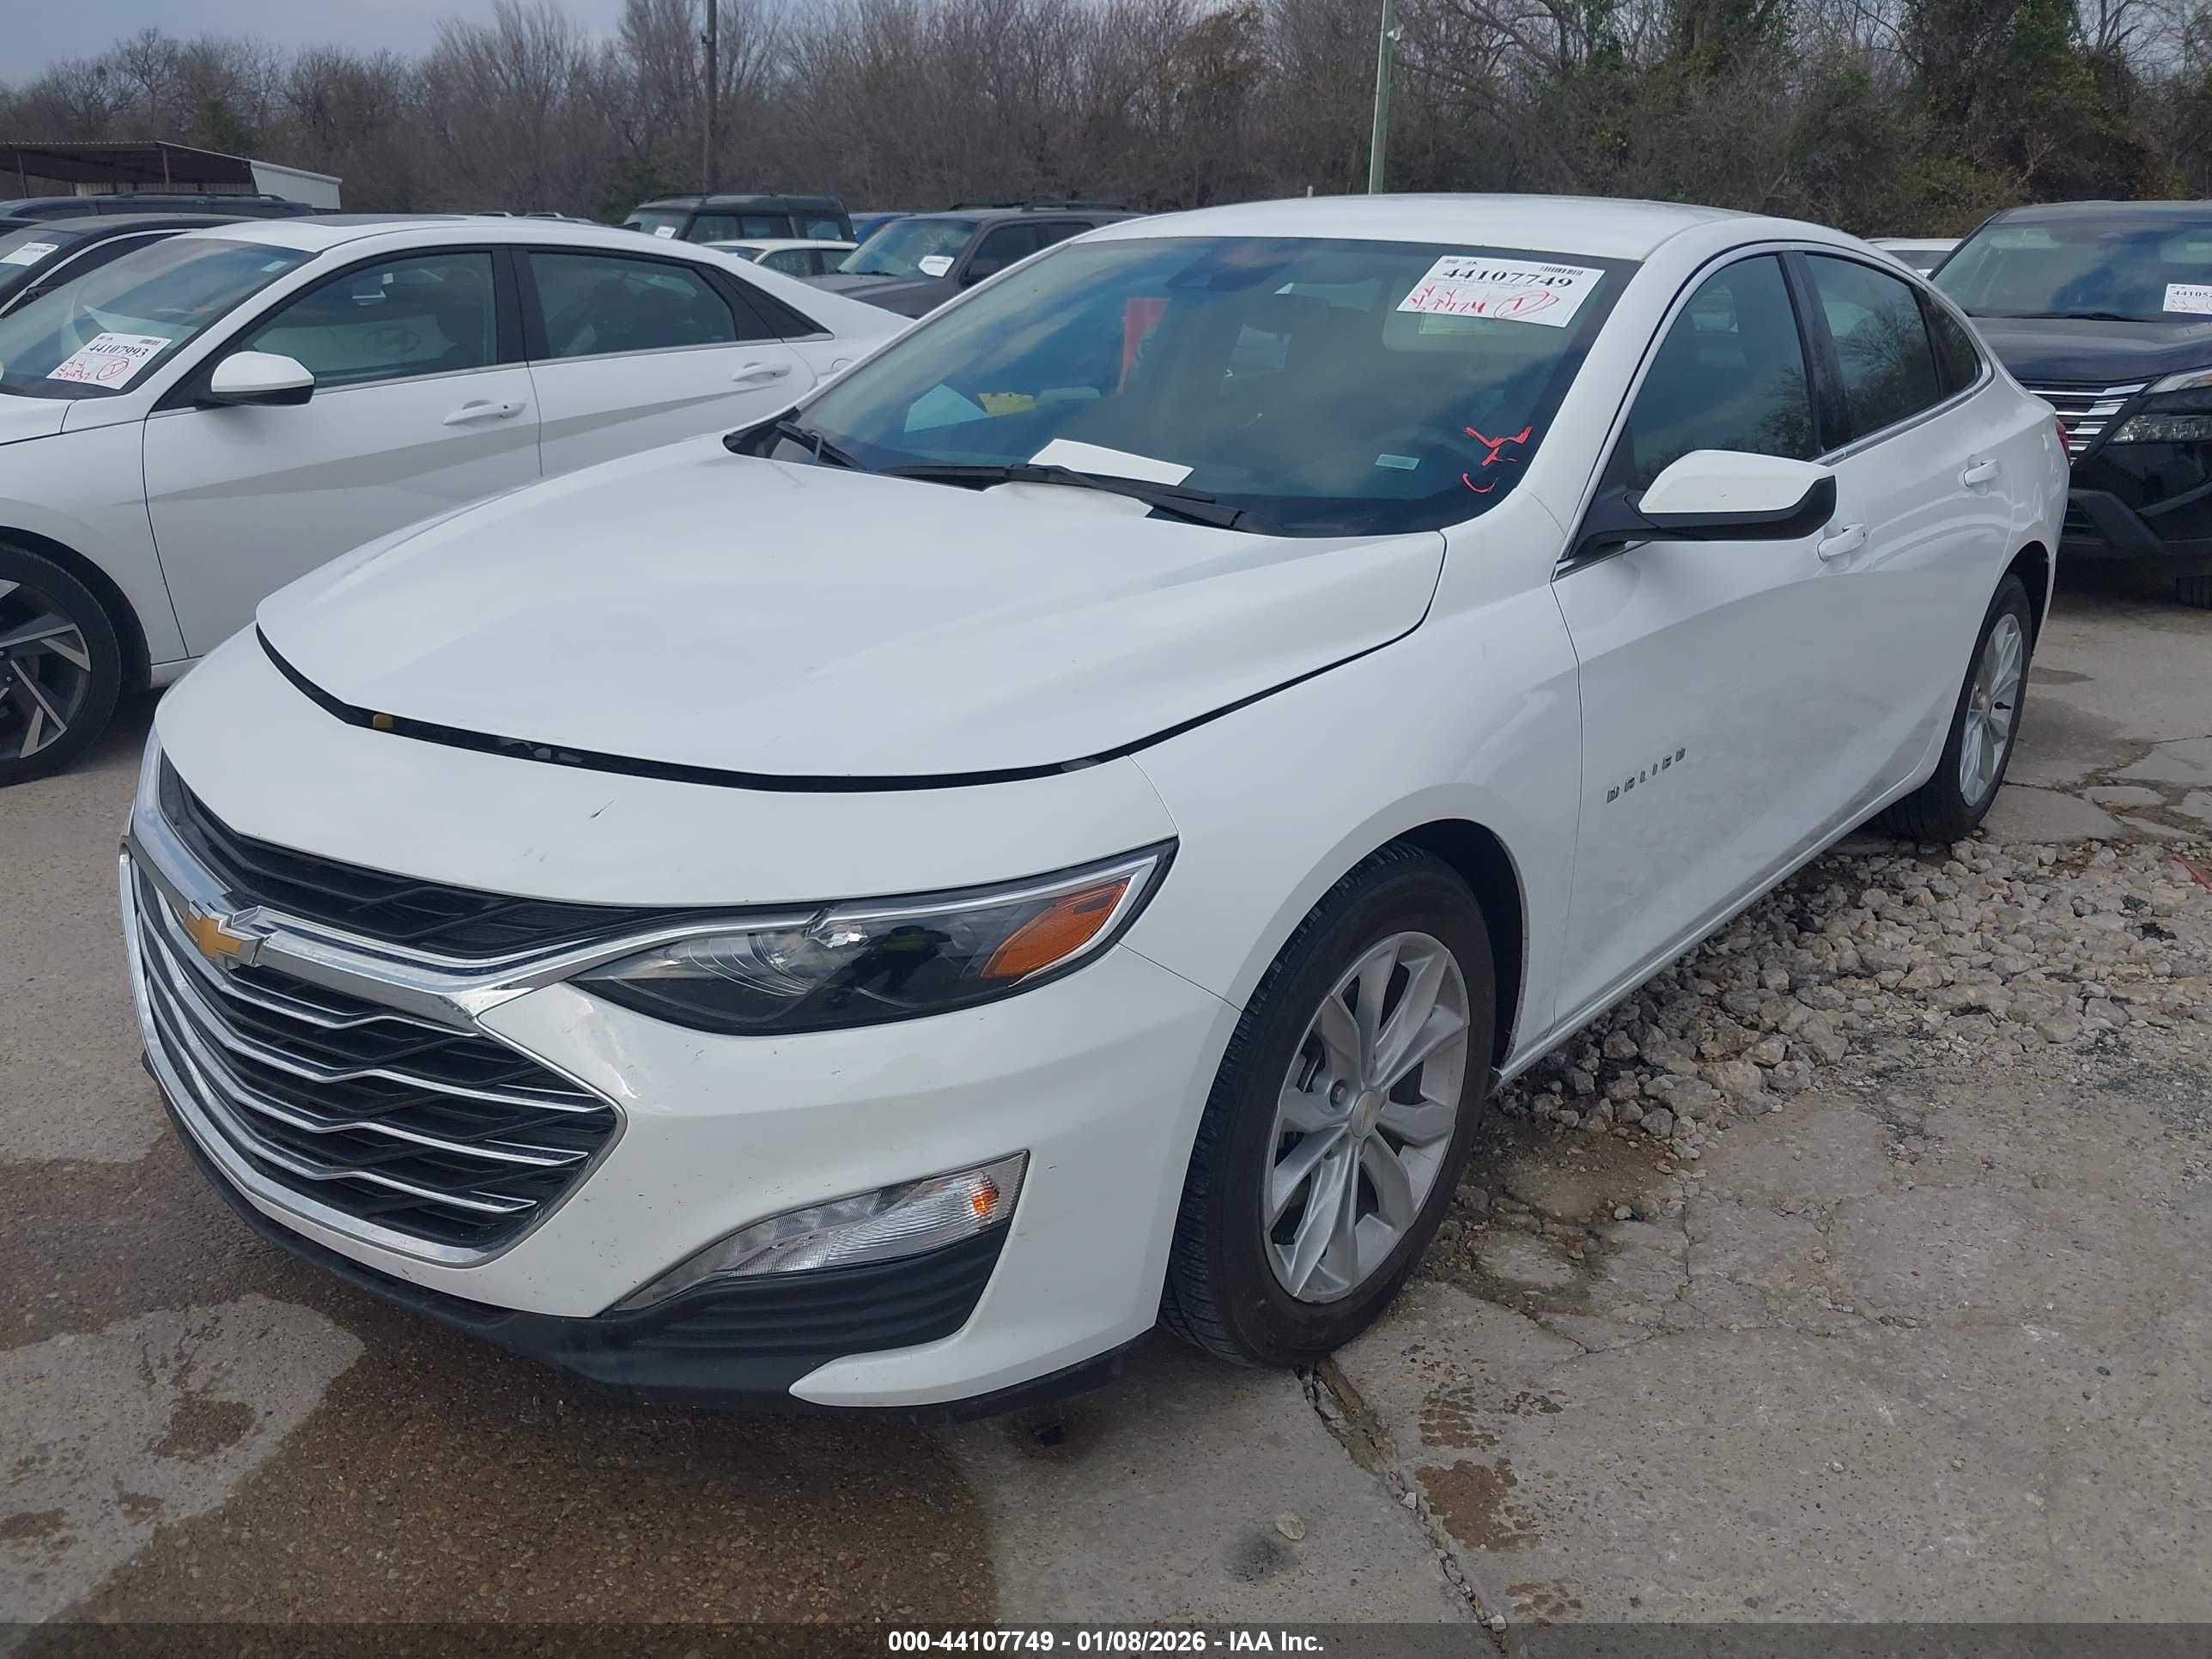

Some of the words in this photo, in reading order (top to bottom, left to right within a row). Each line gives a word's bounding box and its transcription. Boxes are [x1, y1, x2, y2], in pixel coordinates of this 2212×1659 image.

[1442, 268, 1573, 289] 44107749
[88, 343, 149, 358] 44107993
[1607, 747, 1686, 804] MALIBU
